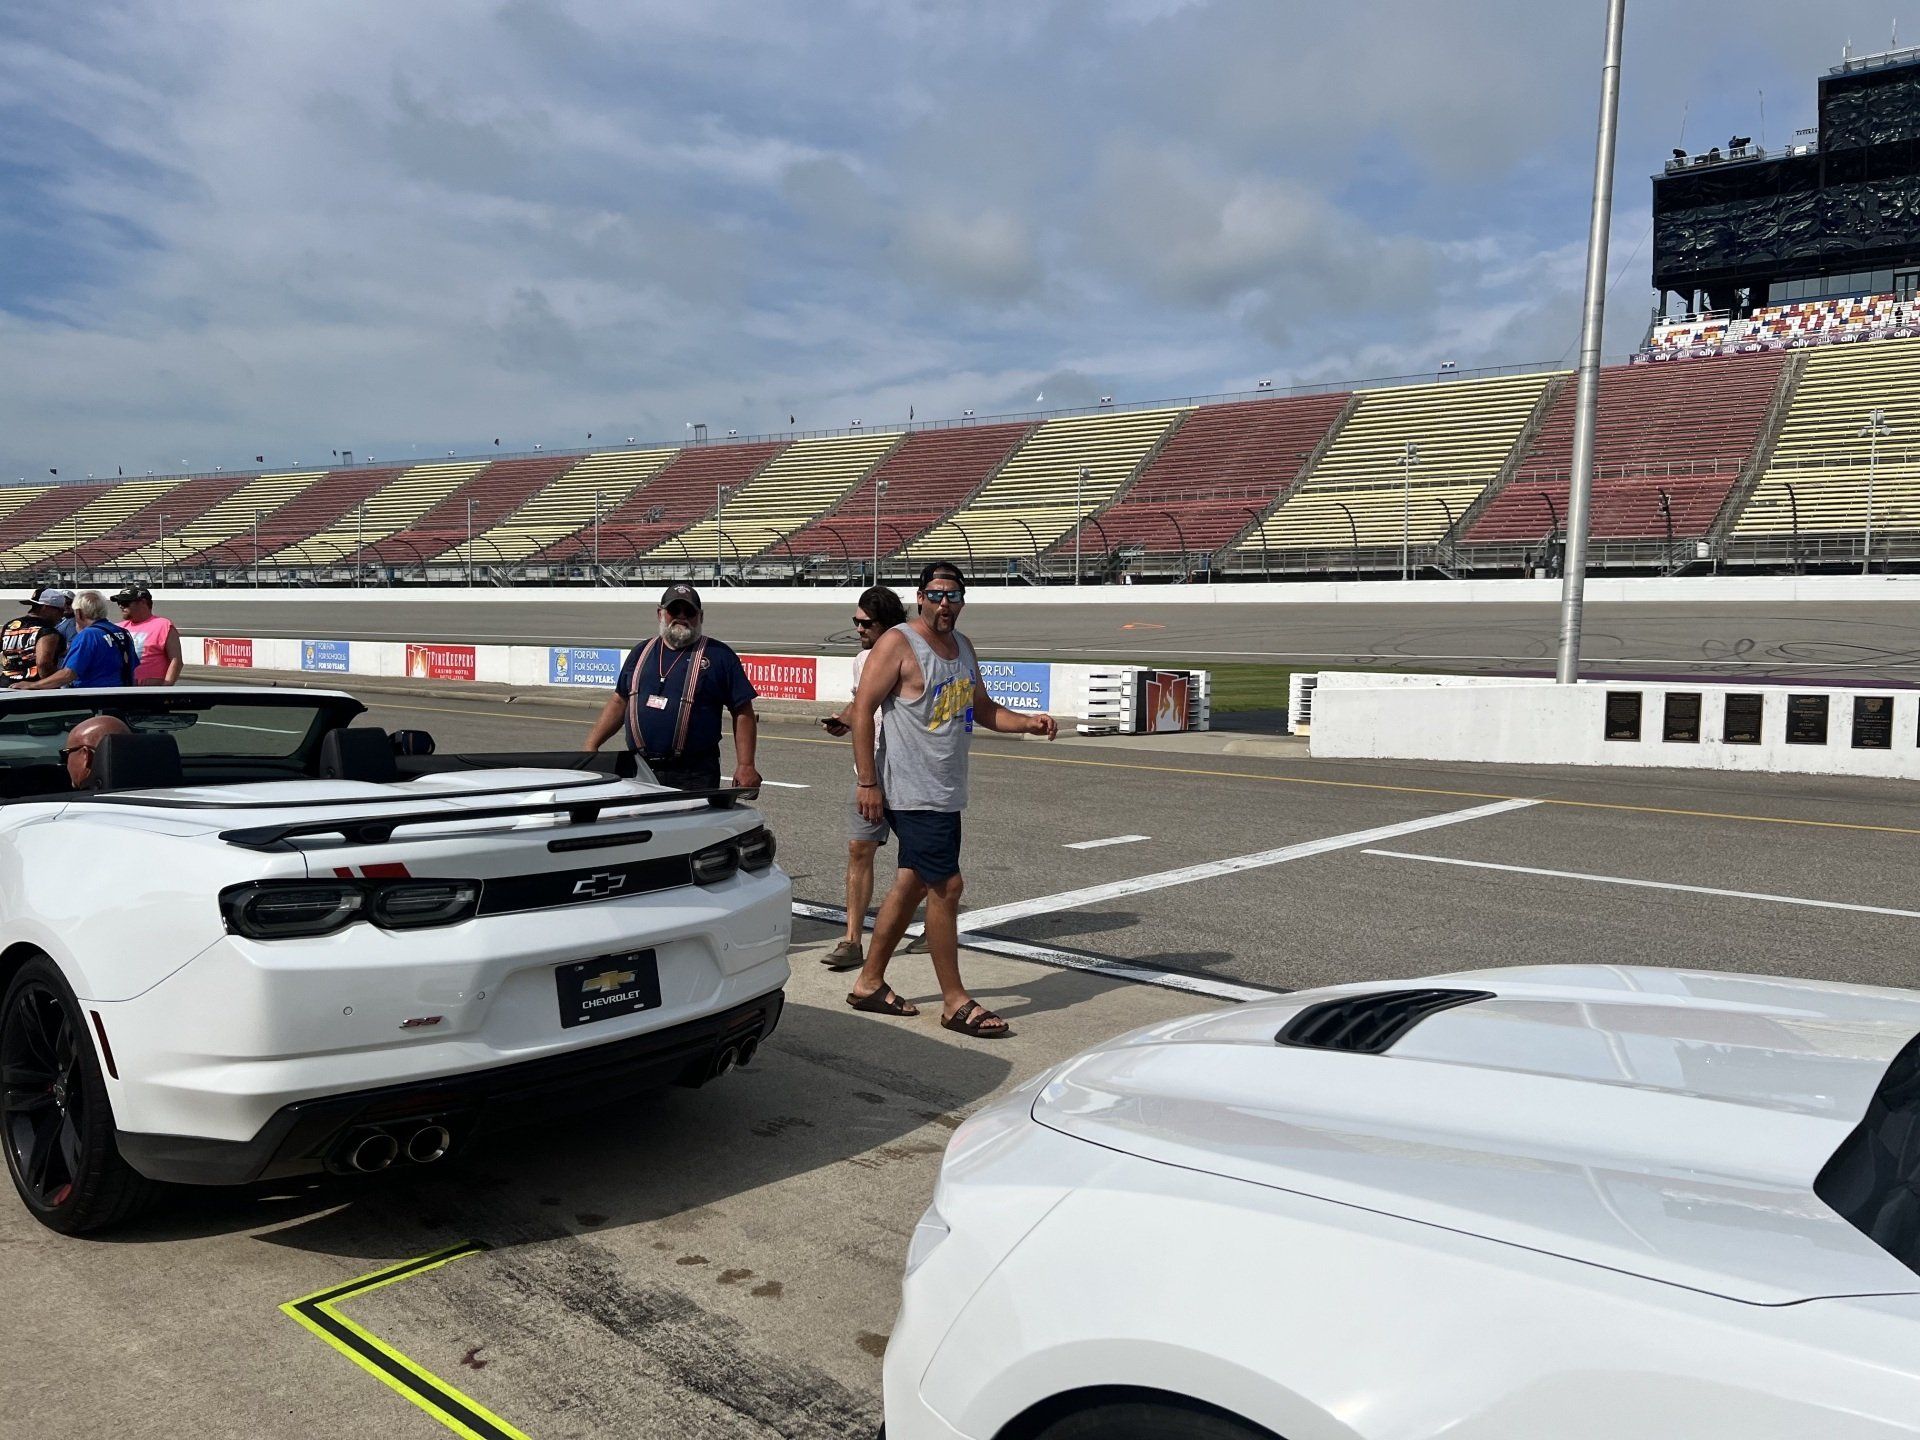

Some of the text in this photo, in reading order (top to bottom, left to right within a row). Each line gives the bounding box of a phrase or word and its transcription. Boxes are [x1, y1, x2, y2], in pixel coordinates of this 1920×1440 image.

[1655, 353, 1671, 362] ally
[1700, 348, 1716, 357] ally
[1745, 342, 1761, 352] ally
[1793, 338, 1809, 347] ally
[1841, 333, 1859, 343] ally
[1894, 328, 1913, 338] ally
[574, 650, 585, 659] FOR
[574, 662, 585, 671] FOR
[979, 665, 1016, 677] OR FUN.
[574, 674, 617, 685] FOR 50 YEARS.
[753, 684, 806, 694] CASINO HOTEL
[994, 681, 1042, 693] SCHOOLS.
[1007, 697, 1041, 708] YEARS.
[582, 989, 641, 1010] CHEVROLET
